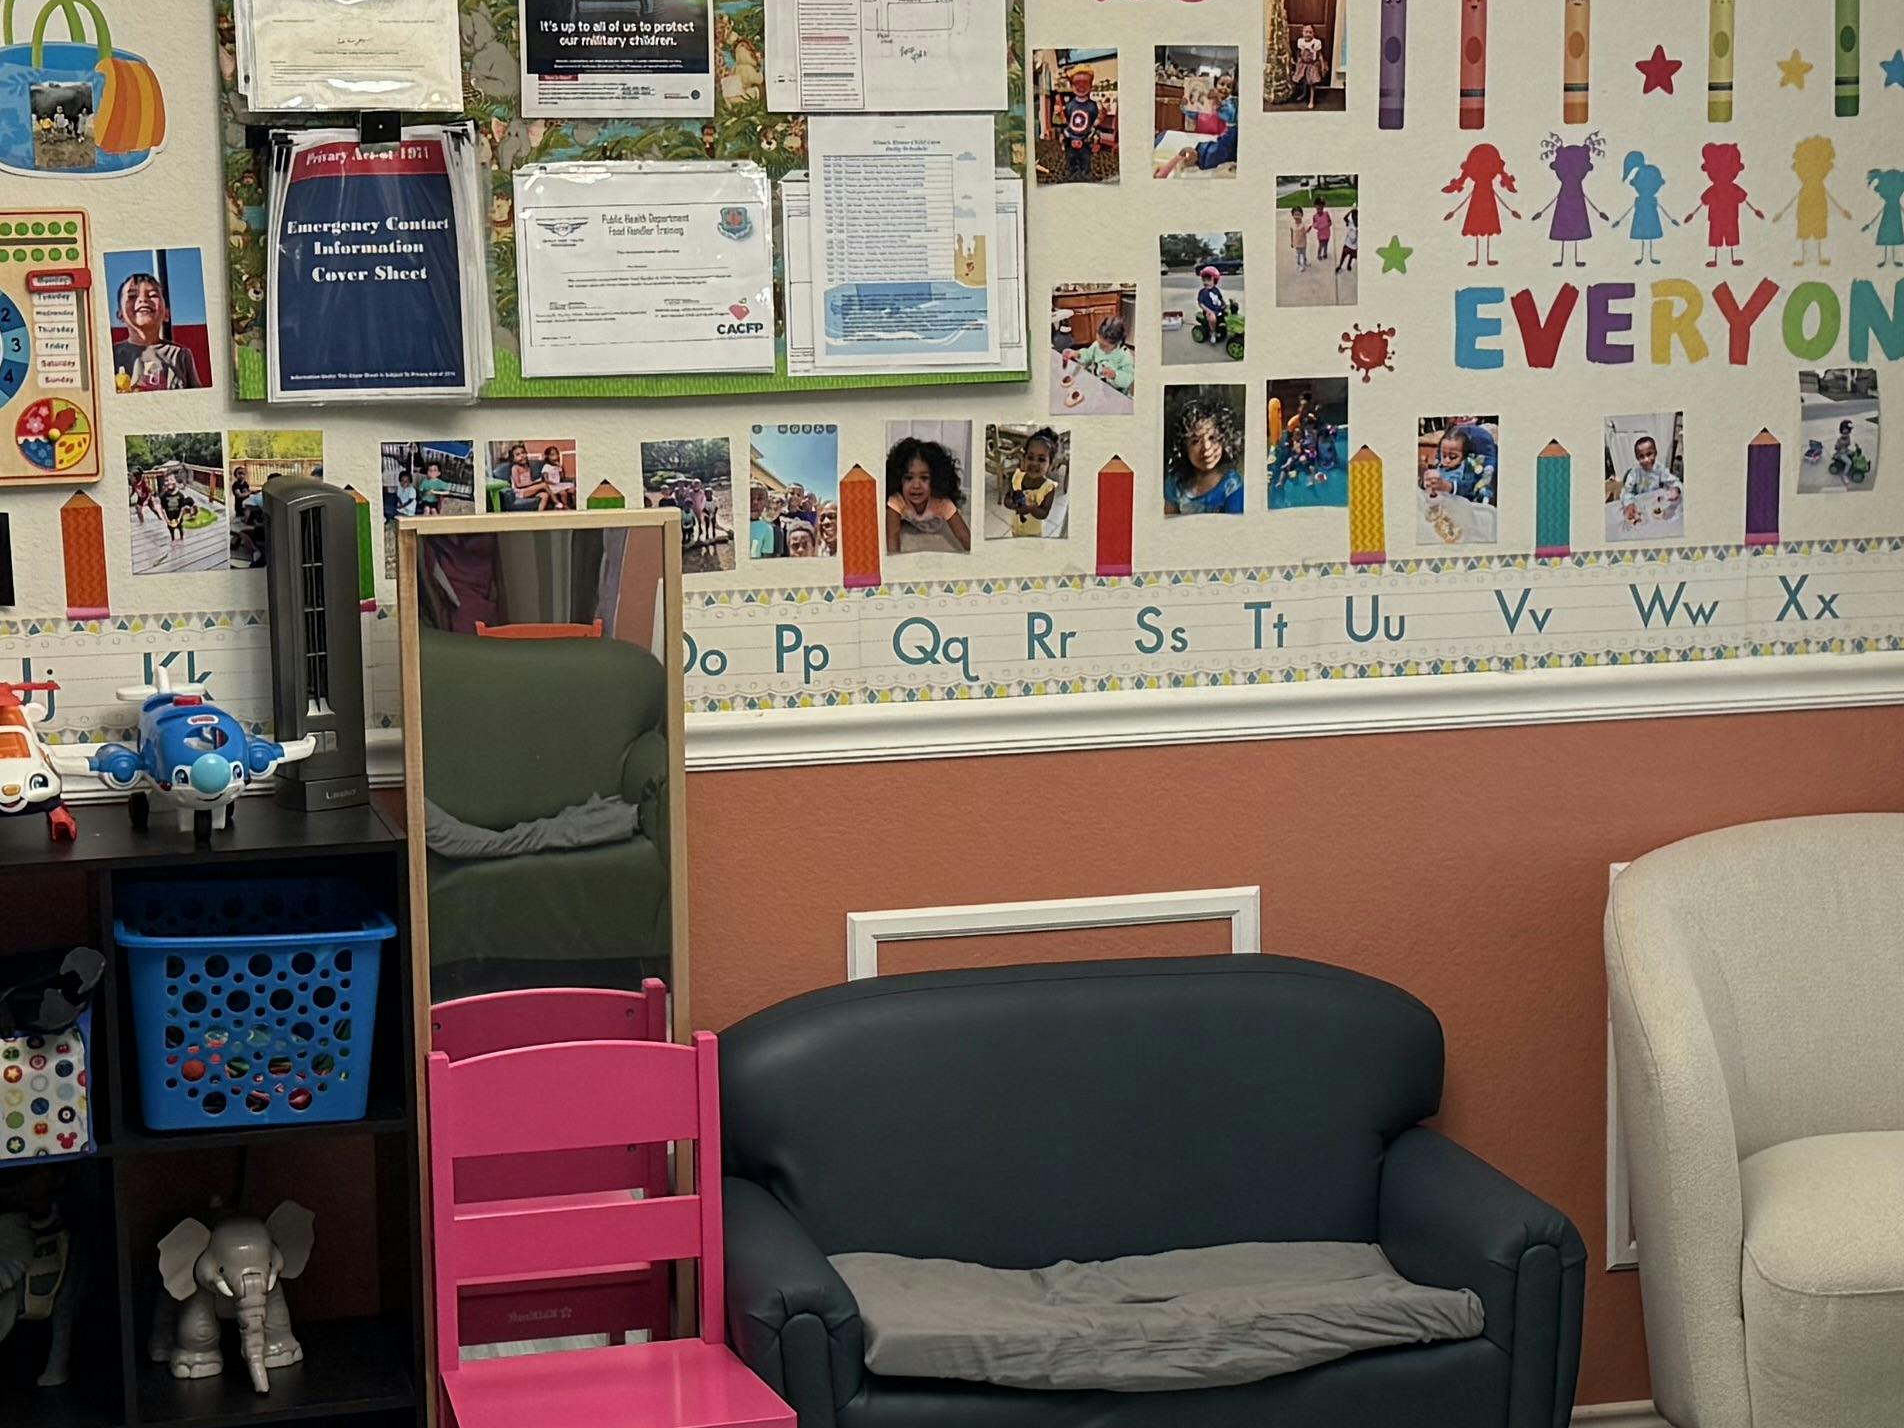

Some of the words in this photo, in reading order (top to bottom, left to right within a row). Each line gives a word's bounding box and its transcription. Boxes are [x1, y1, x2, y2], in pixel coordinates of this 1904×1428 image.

[561, 21, 575, 34] up
[579, 22, 589, 32] to
[609, 21, 620, 31] of
[623, 23, 636, 31] us
[640, 22, 651, 32] to
[654, 22, 694, 33] protect
[560, 37, 578, 46] our
[582, 35, 626, 48] military
[629, 35, 677, 46] children.
[287, 221, 380, 236] Emergency
[386, 217, 449, 232] Contact
[314, 240, 424, 255] Information
[312, 267, 368, 282] Cover
[374, 265, 427, 280] Sheet
[717, 323, 763, 334] CACFP
[775, 624, 829, 684] Pp
[1630, 581, 1720, 629] Ww
[1776, 575, 1842, 623] Xx
